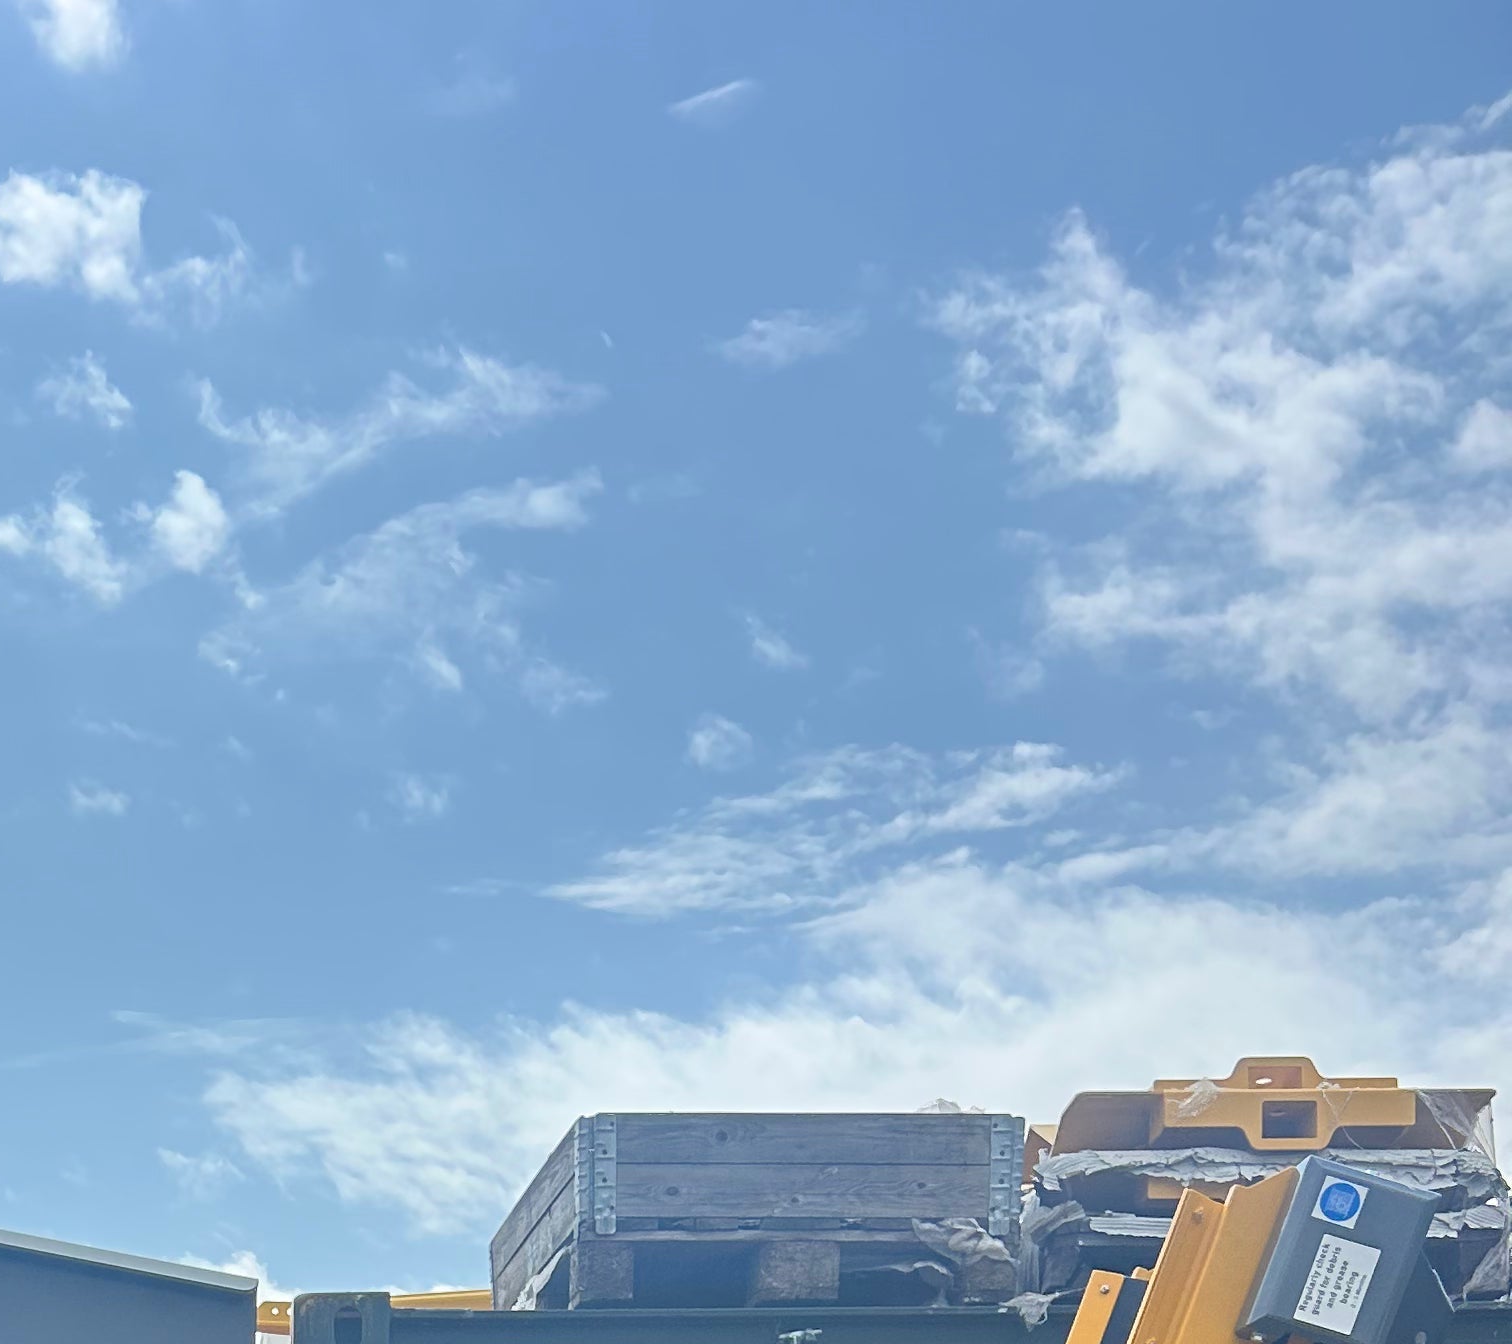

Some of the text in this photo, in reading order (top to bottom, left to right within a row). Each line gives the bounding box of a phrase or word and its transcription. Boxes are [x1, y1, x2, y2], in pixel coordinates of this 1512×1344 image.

[1316, 1243, 1331, 1268] check
[1312, 1247, 1342, 1315] guard for debris
[1326, 1260, 1349, 1308] and grease
[1339, 1271, 1359, 1304] bearing
